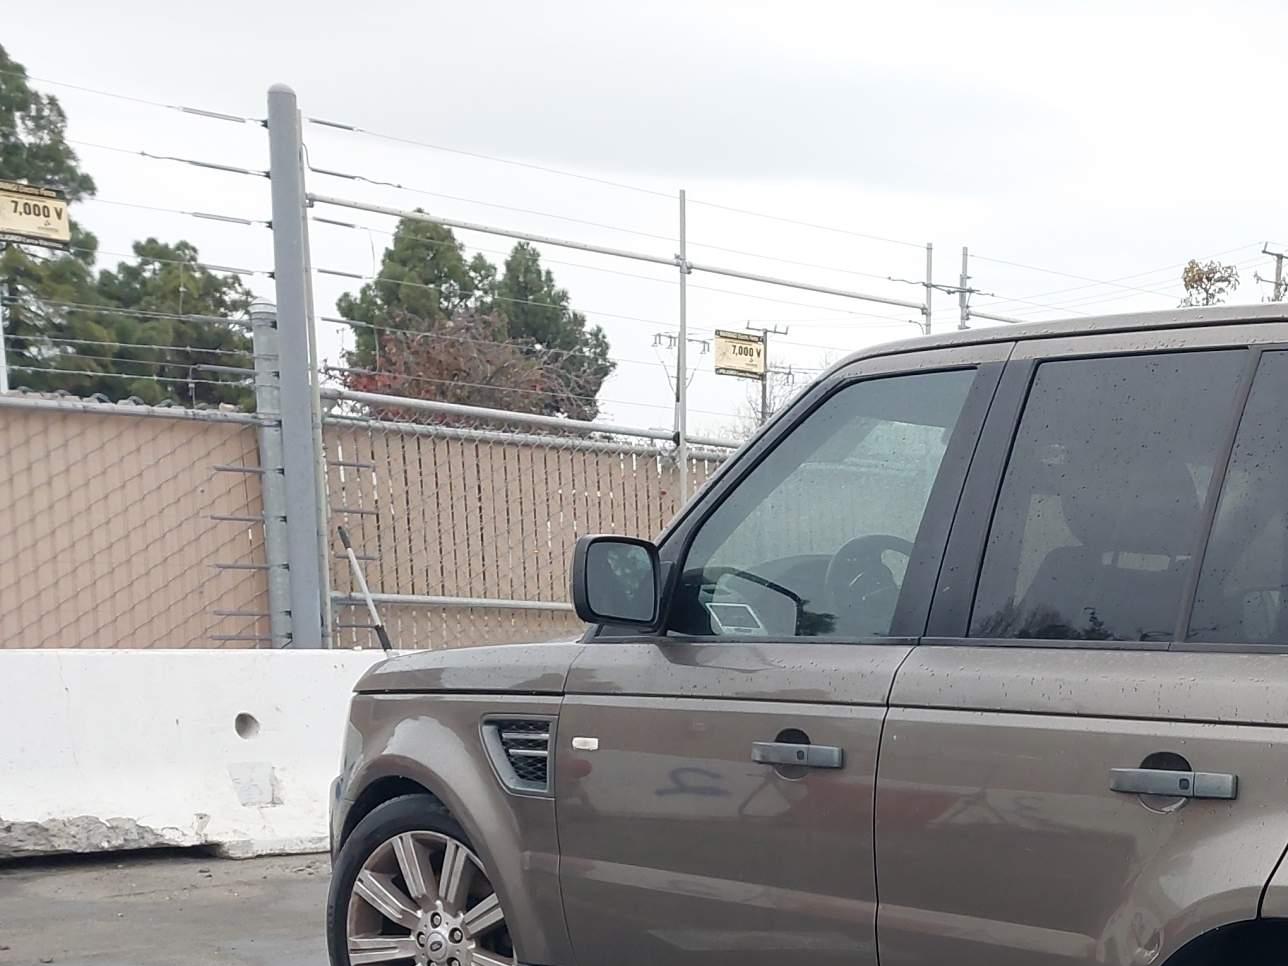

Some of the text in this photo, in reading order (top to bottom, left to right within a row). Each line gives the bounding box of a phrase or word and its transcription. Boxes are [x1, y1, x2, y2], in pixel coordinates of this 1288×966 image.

[10, 199, 63, 221] 7,000 V
[731, 344, 762, 358] 7,000 V
